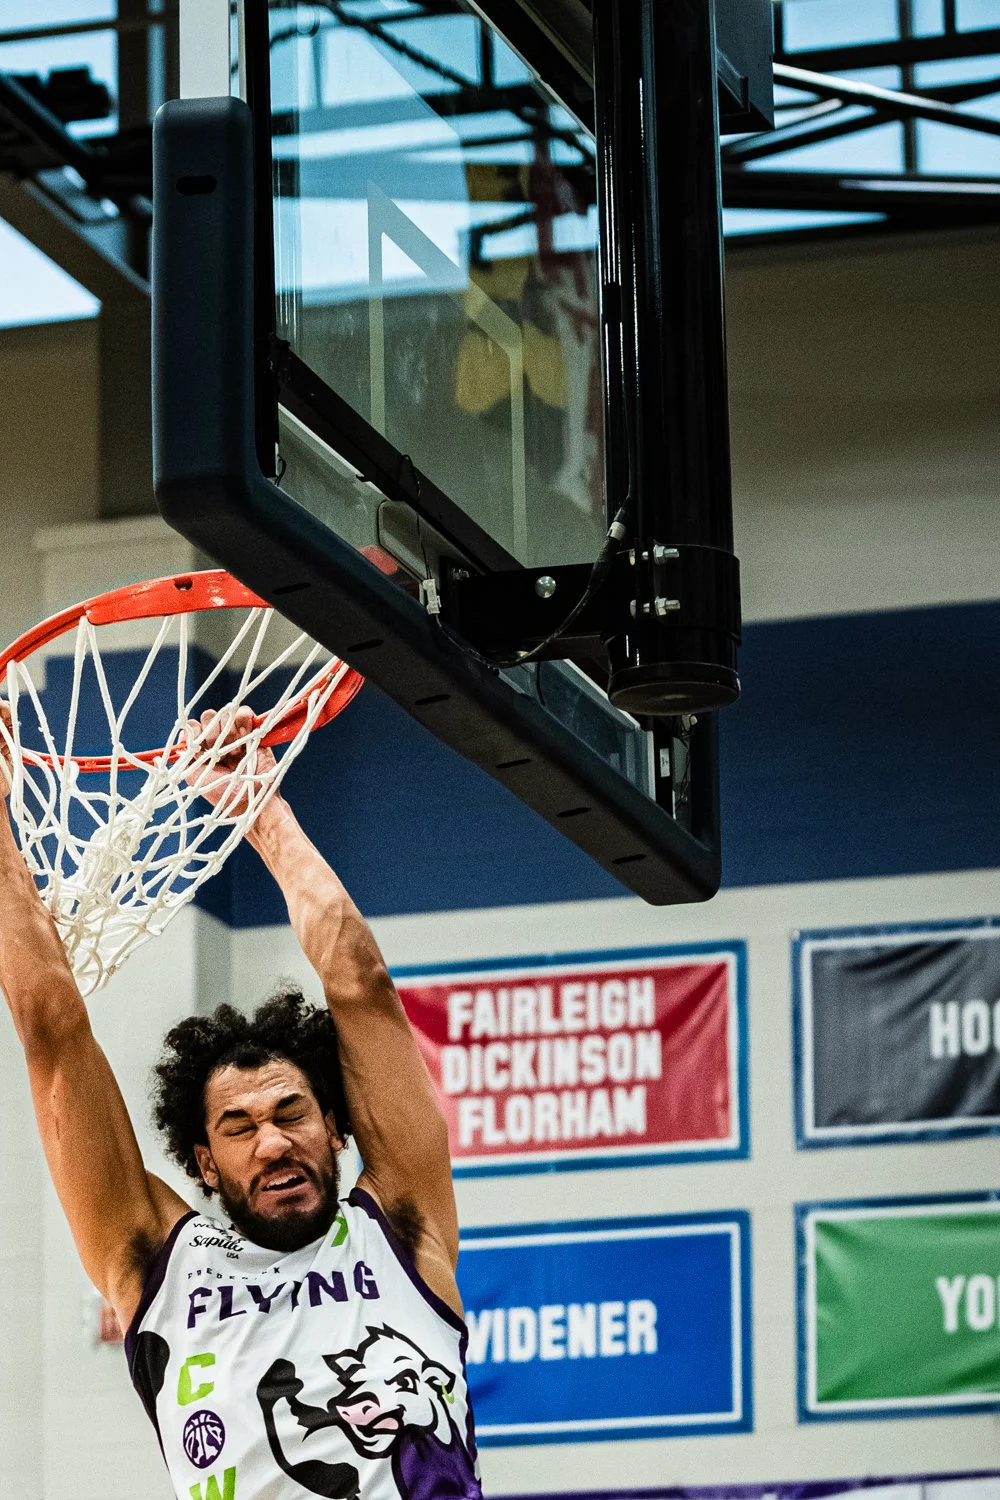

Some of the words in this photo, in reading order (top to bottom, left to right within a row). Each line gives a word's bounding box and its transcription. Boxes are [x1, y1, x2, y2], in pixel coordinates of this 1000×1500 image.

[447, 977, 656, 1042] FAIRLEIGH
[929, 998, 1000, 1059] HO
[442, 1031, 662, 1094] DICKINSON
[458, 1085, 647, 1148] FLORHAM
[226, 1252, 240, 1260] USA
[187, 1260, 381, 1330] FLYING
[936, 1274, 1000, 1334] YO
